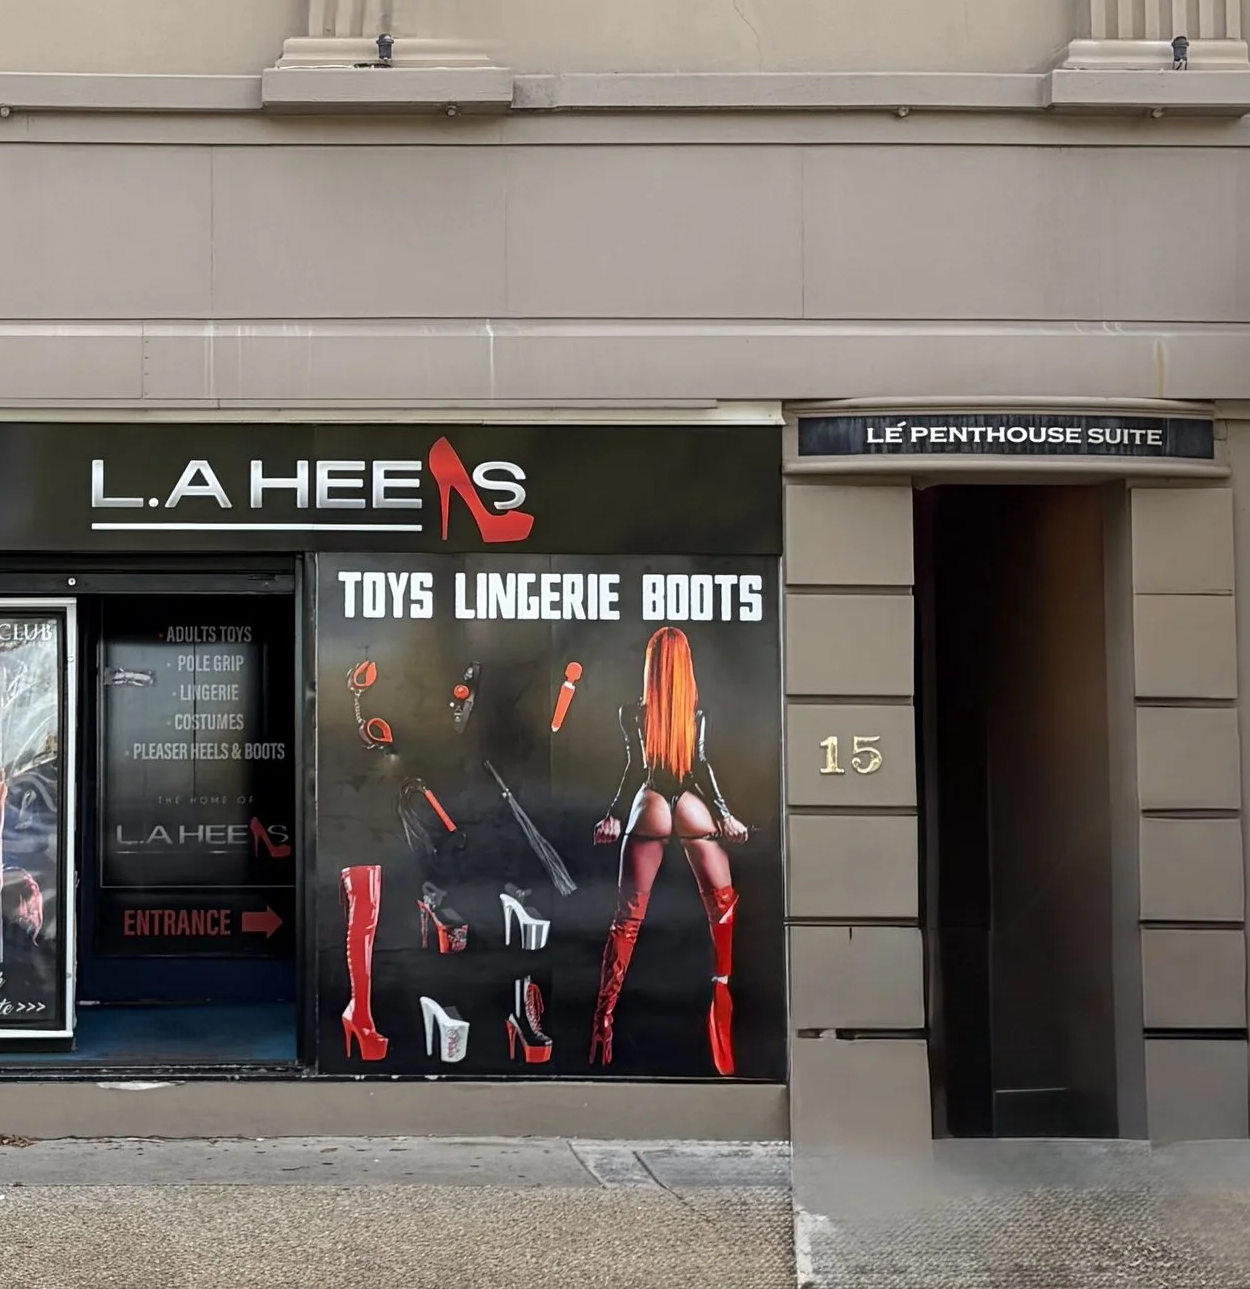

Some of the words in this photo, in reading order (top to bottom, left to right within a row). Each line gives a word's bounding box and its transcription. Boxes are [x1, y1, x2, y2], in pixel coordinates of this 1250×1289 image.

[910, 426, 1082, 444] PENTHOUSE
[1087, 428, 1164, 446] SUITE
[338, 571, 434, 619] TOYS
[454, 572, 621, 621] LINGERIE
[641, 573, 763, 621] BOOTS
[166, 625, 217, 643] ADULTS
[219, 625, 253, 643] TOYS
[178, 654, 210, 672] POLE
[213, 654, 244, 672] GRIP
[180, 684, 239, 701] LINGERIE
[174, 713, 245, 730] COSTUMES
[133, 742, 188, 760] PLEASER
[190, 742, 229, 760] HEELS
[231, 742, 242, 760] &
[244, 742, 285, 760] BOOTS
[819, 735, 883, 774] 15
[190, 795, 228, 805] HOME
[123, 909, 232, 936] ENTRANCE
